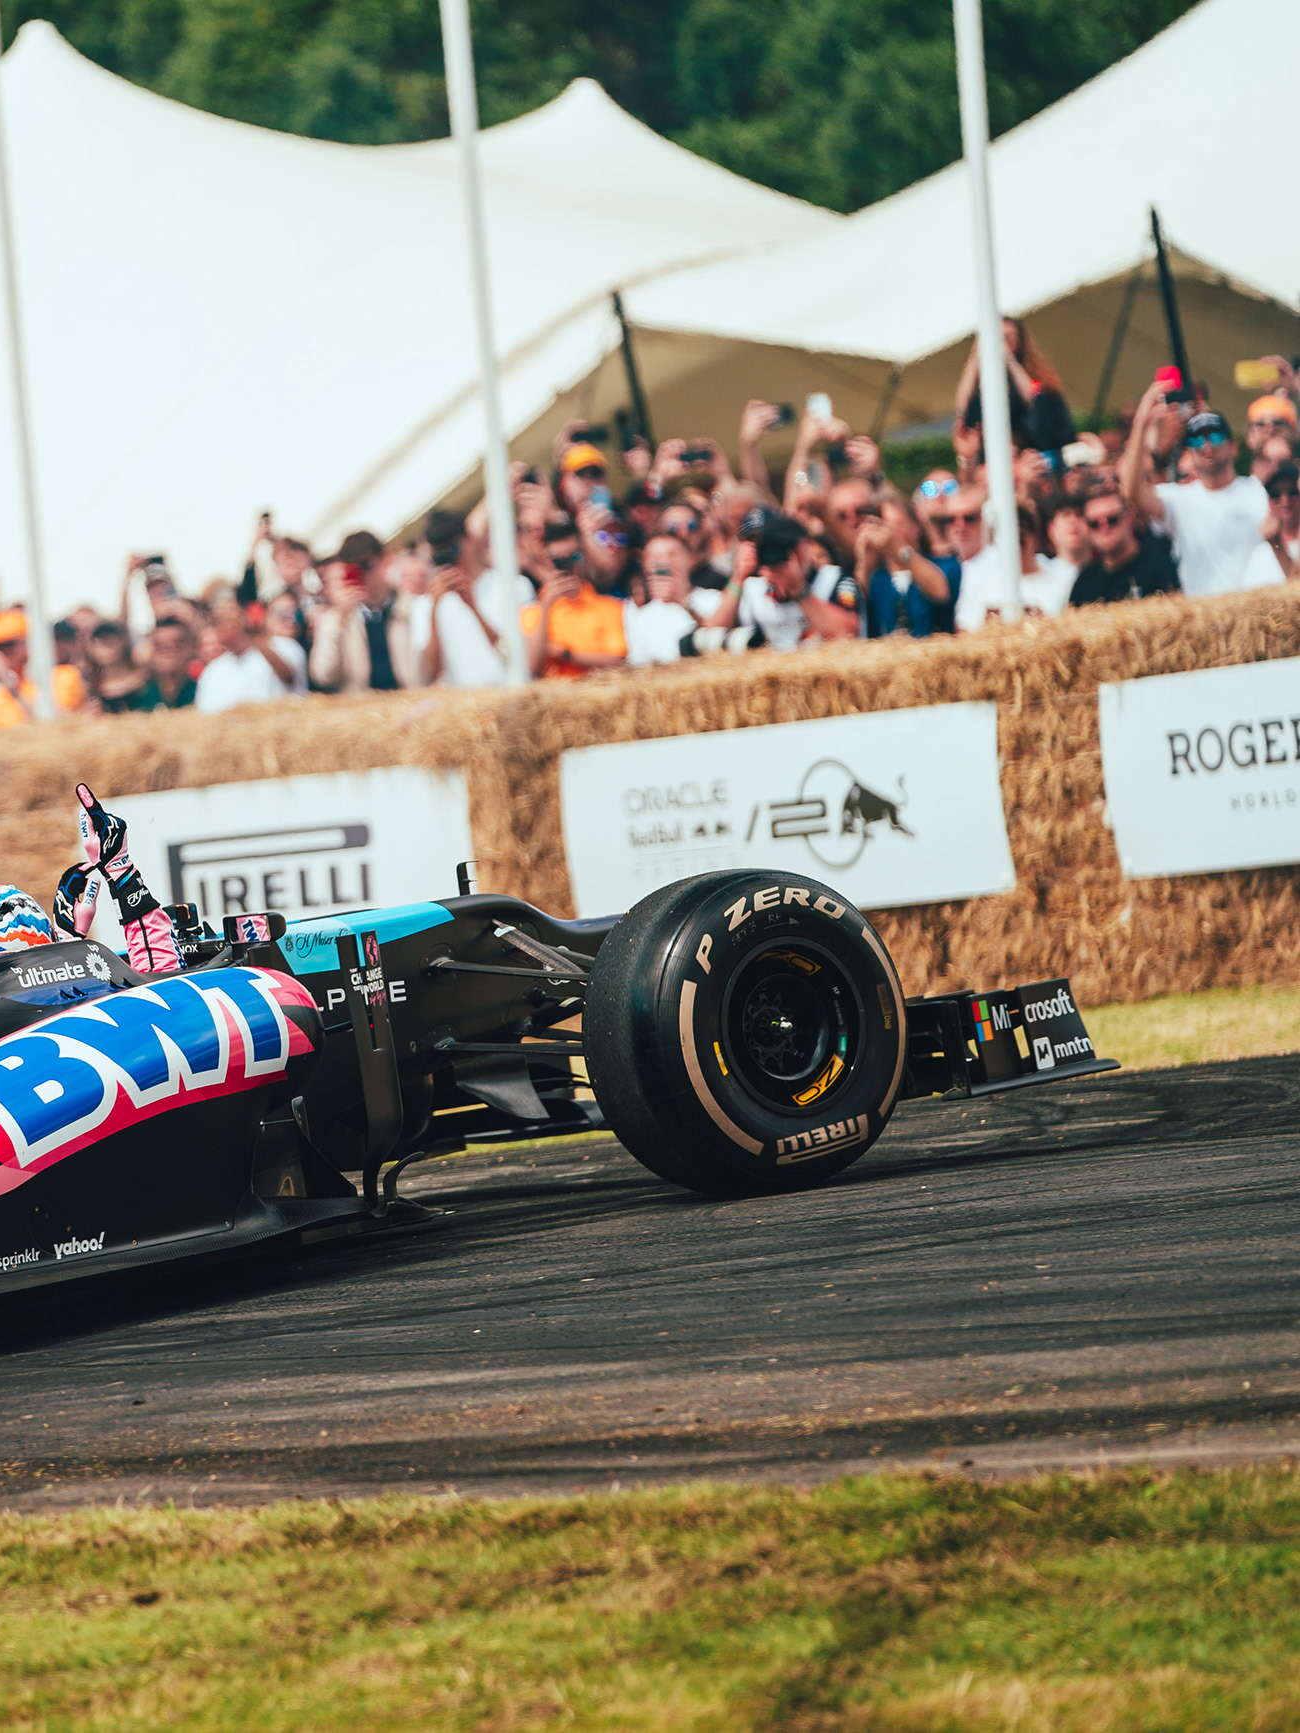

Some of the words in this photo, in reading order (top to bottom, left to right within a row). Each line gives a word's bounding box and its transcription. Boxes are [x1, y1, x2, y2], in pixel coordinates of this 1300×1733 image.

[624, 778, 730, 814] ORACLE
[723, 885, 847, 932] ZERO
[17, 961, 86, 989] ultimate
[1053, 1035, 1094, 1059] mntn
[775, 1112, 870, 1166] PIRELLI
[53, 1231, 106, 1260] yahoo!
